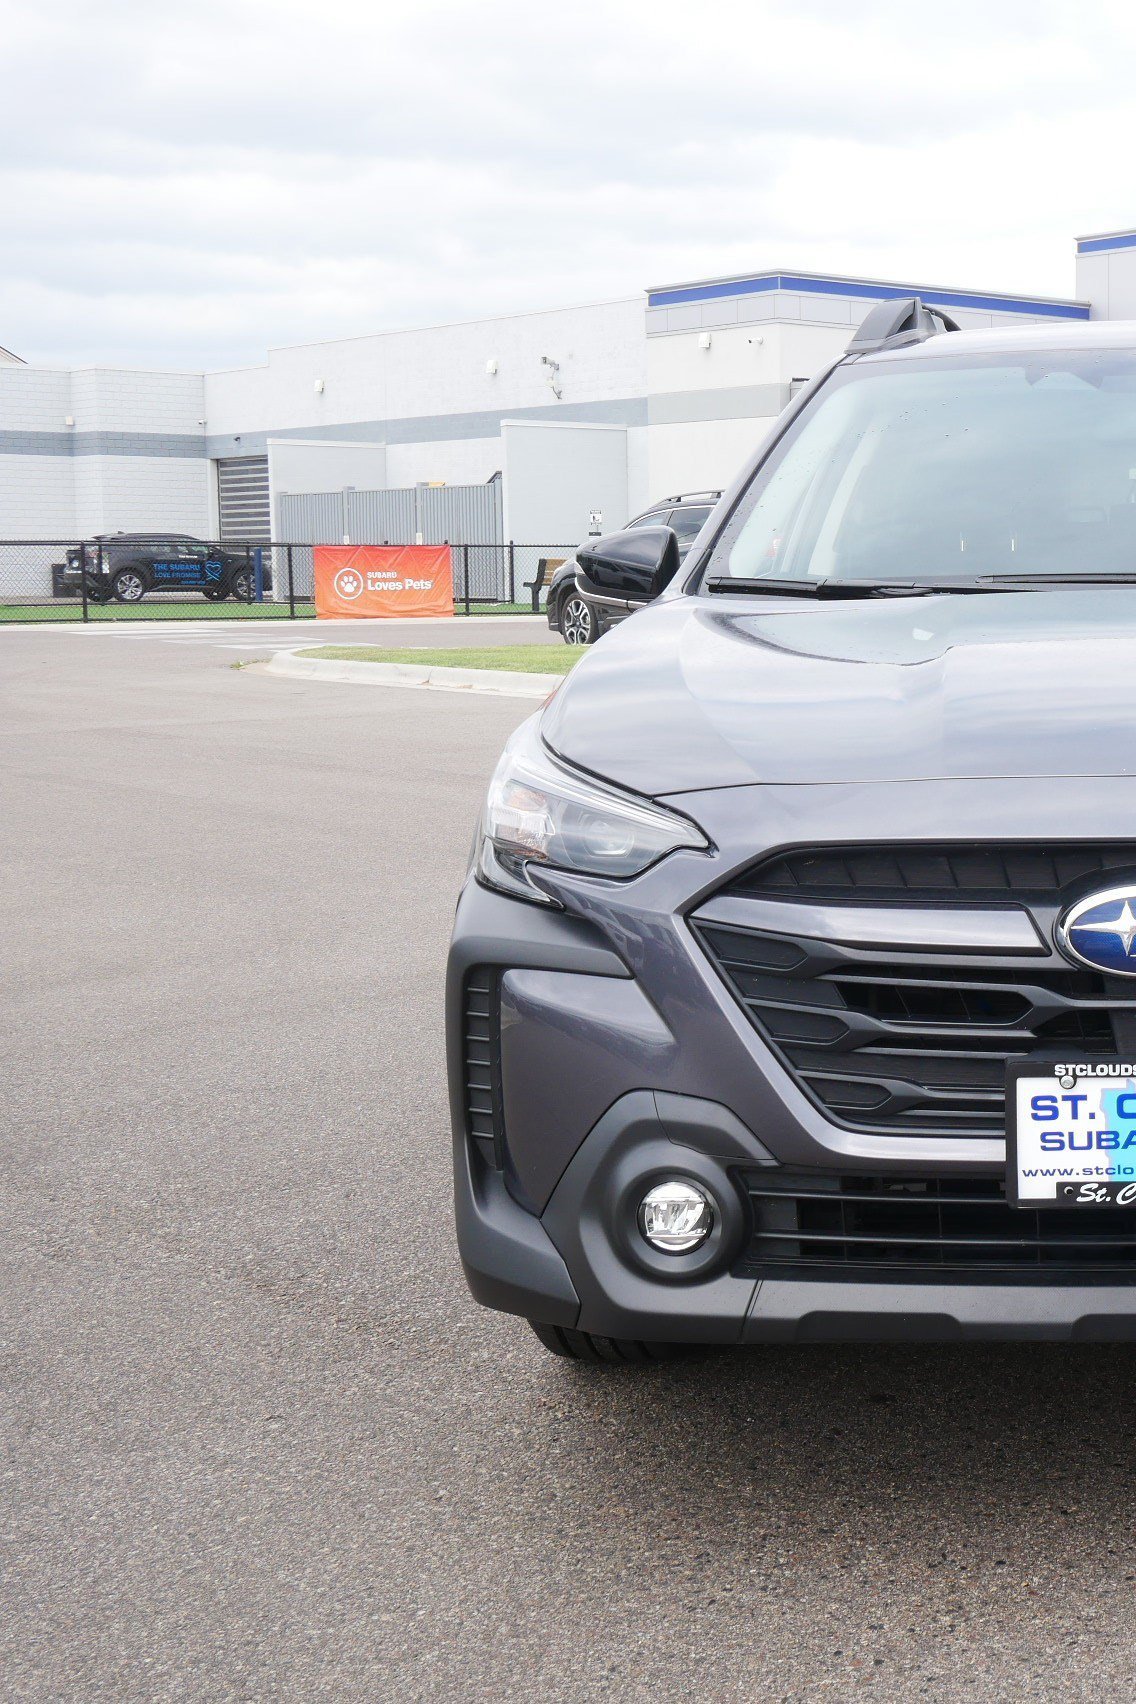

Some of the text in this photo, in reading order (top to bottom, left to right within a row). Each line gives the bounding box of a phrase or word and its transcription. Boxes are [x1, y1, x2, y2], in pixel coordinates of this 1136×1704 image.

[366, 571, 397, 579] SUBARU
[367, 578, 432, 590] Loves Pets
[1030, 1094, 1096, 1121] ST.
[1076, 1182, 1111, 1203] St.
